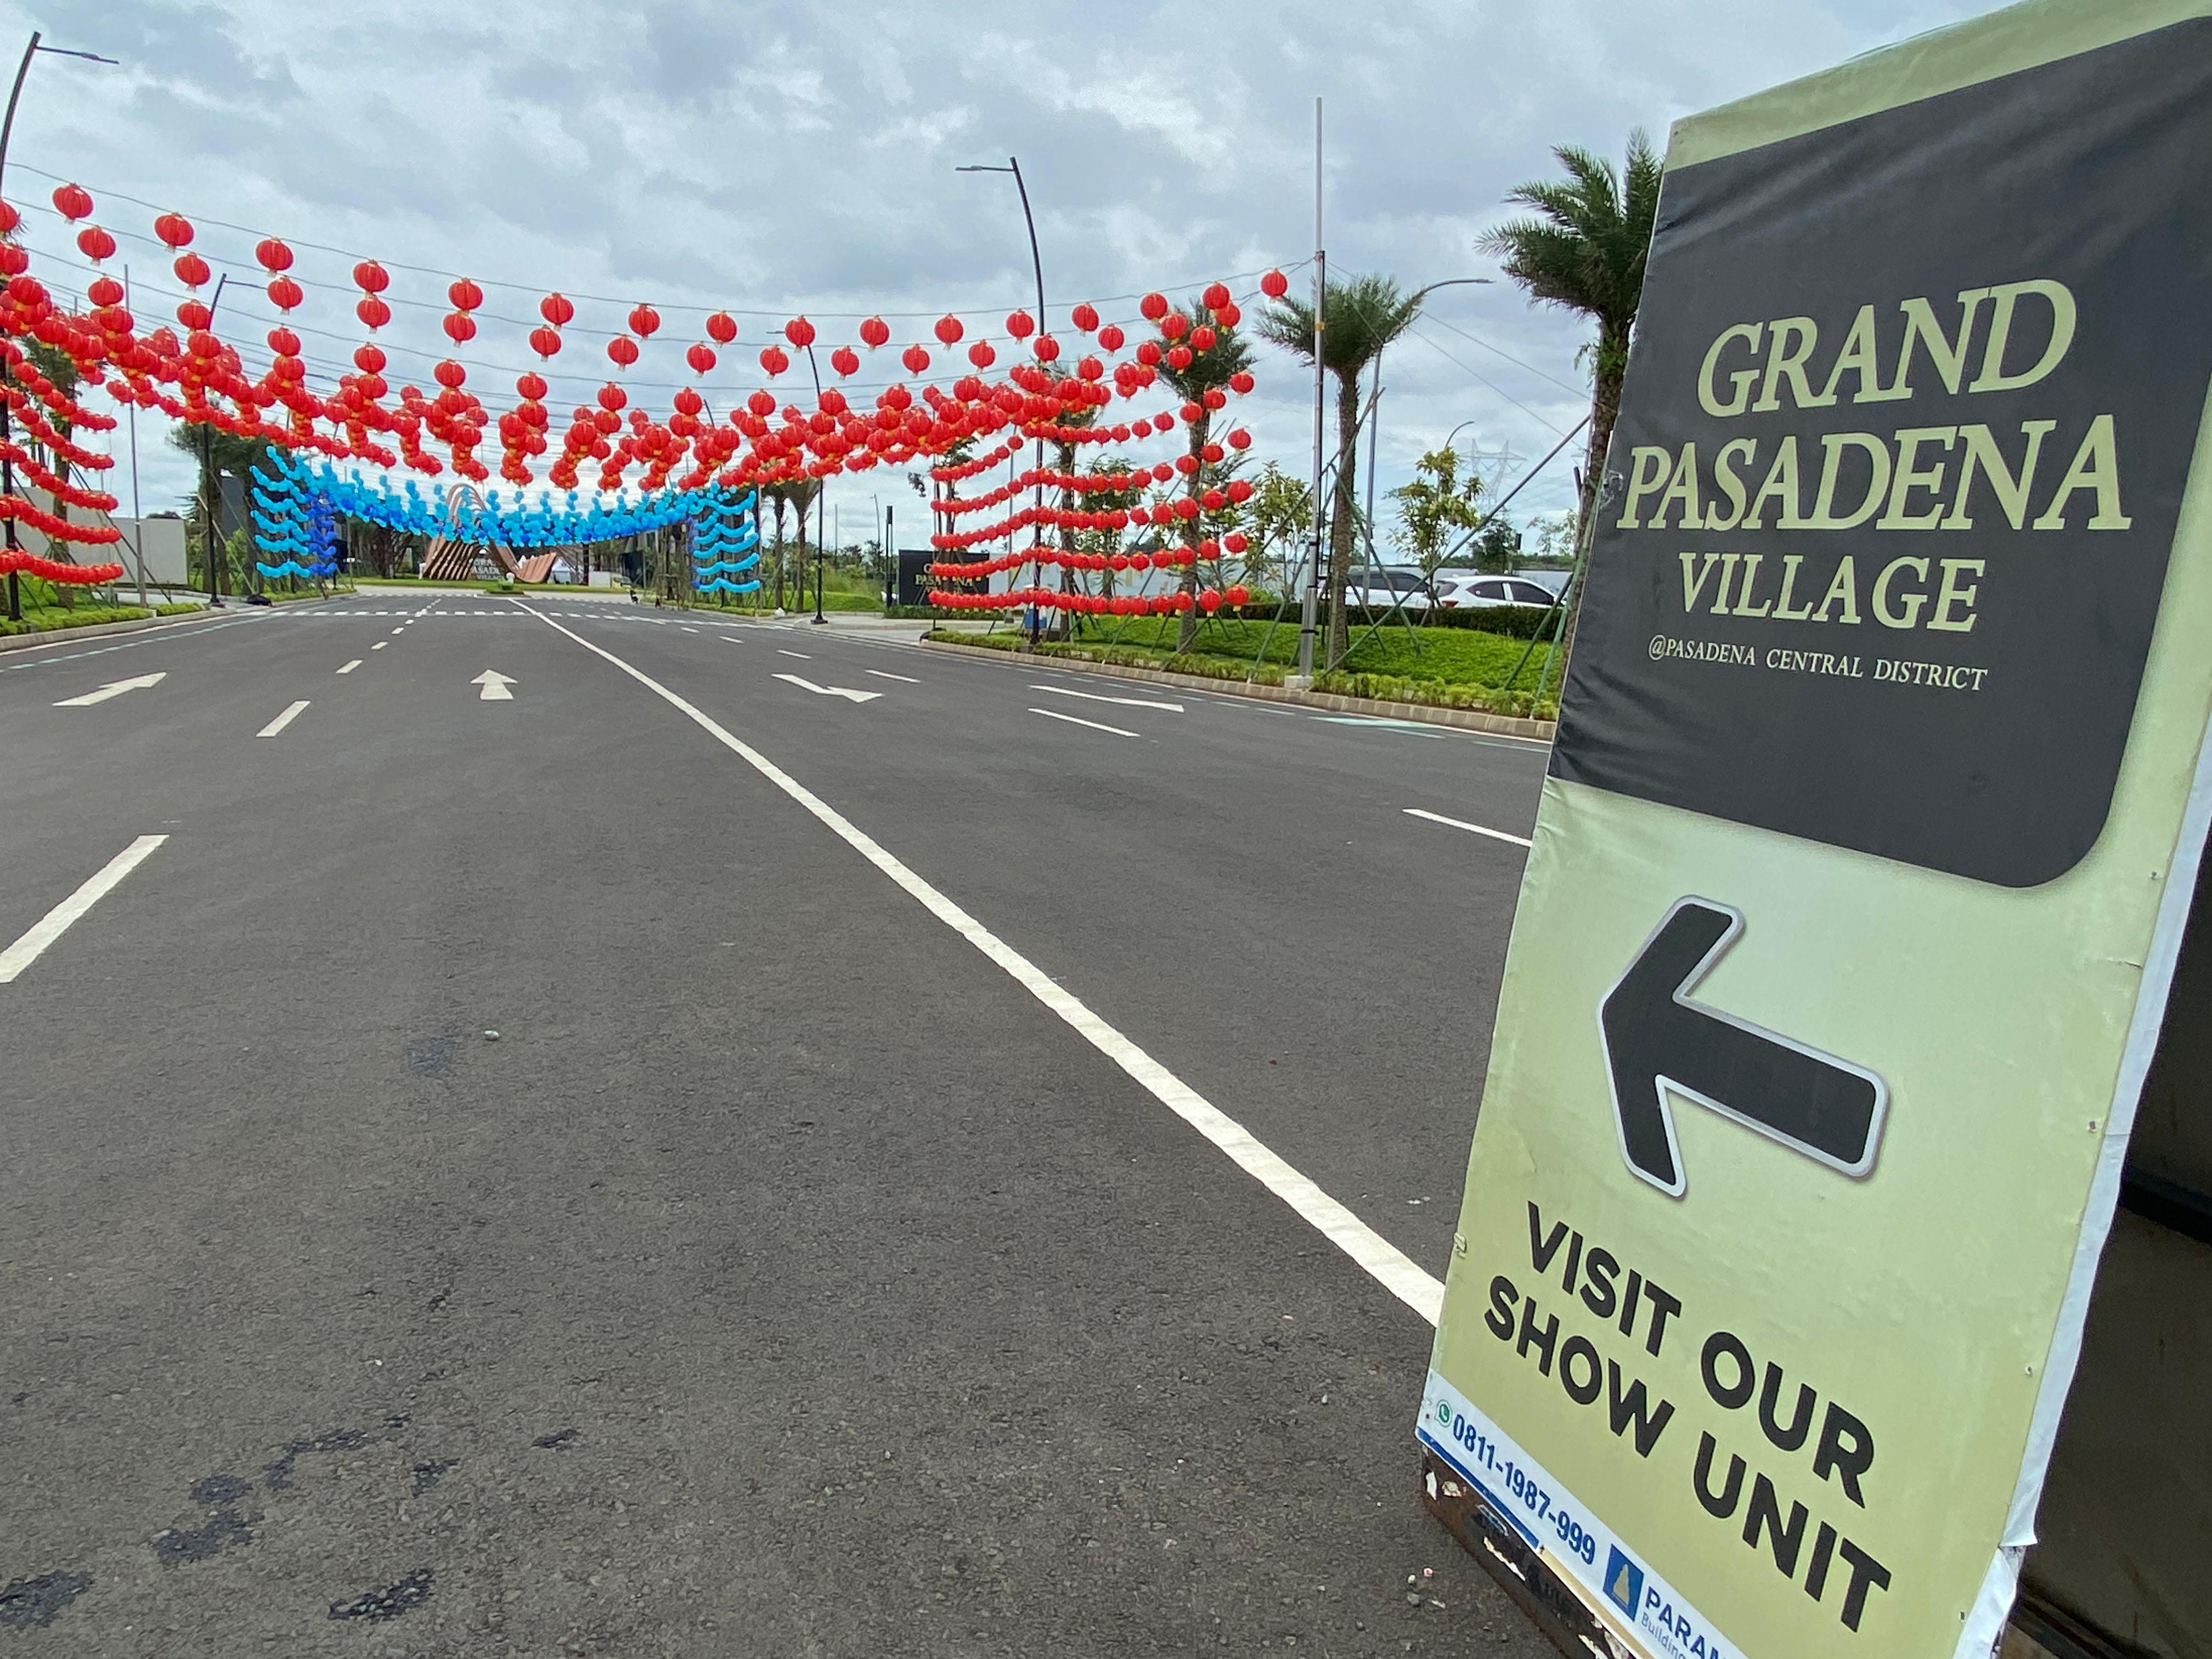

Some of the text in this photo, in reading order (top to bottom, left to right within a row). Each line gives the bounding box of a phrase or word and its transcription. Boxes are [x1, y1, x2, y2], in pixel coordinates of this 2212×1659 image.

[1698, 279, 2077, 417] GRAND
[1616, 414, 2132, 531] PASADENA
[1678, 552, 1985, 632] VILLAGE
[1649, 635, 1988, 691] @PASADENA CENTRAL DISTRICT
[1527, 1200, 1875, 1509] VISIT OUR
[1453, 1413, 1596, 1565] 0811-1987-999
[1484, 1276, 1892, 1633] SHOW UNIT
[1645, 1585, 1726, 1659] PARA
